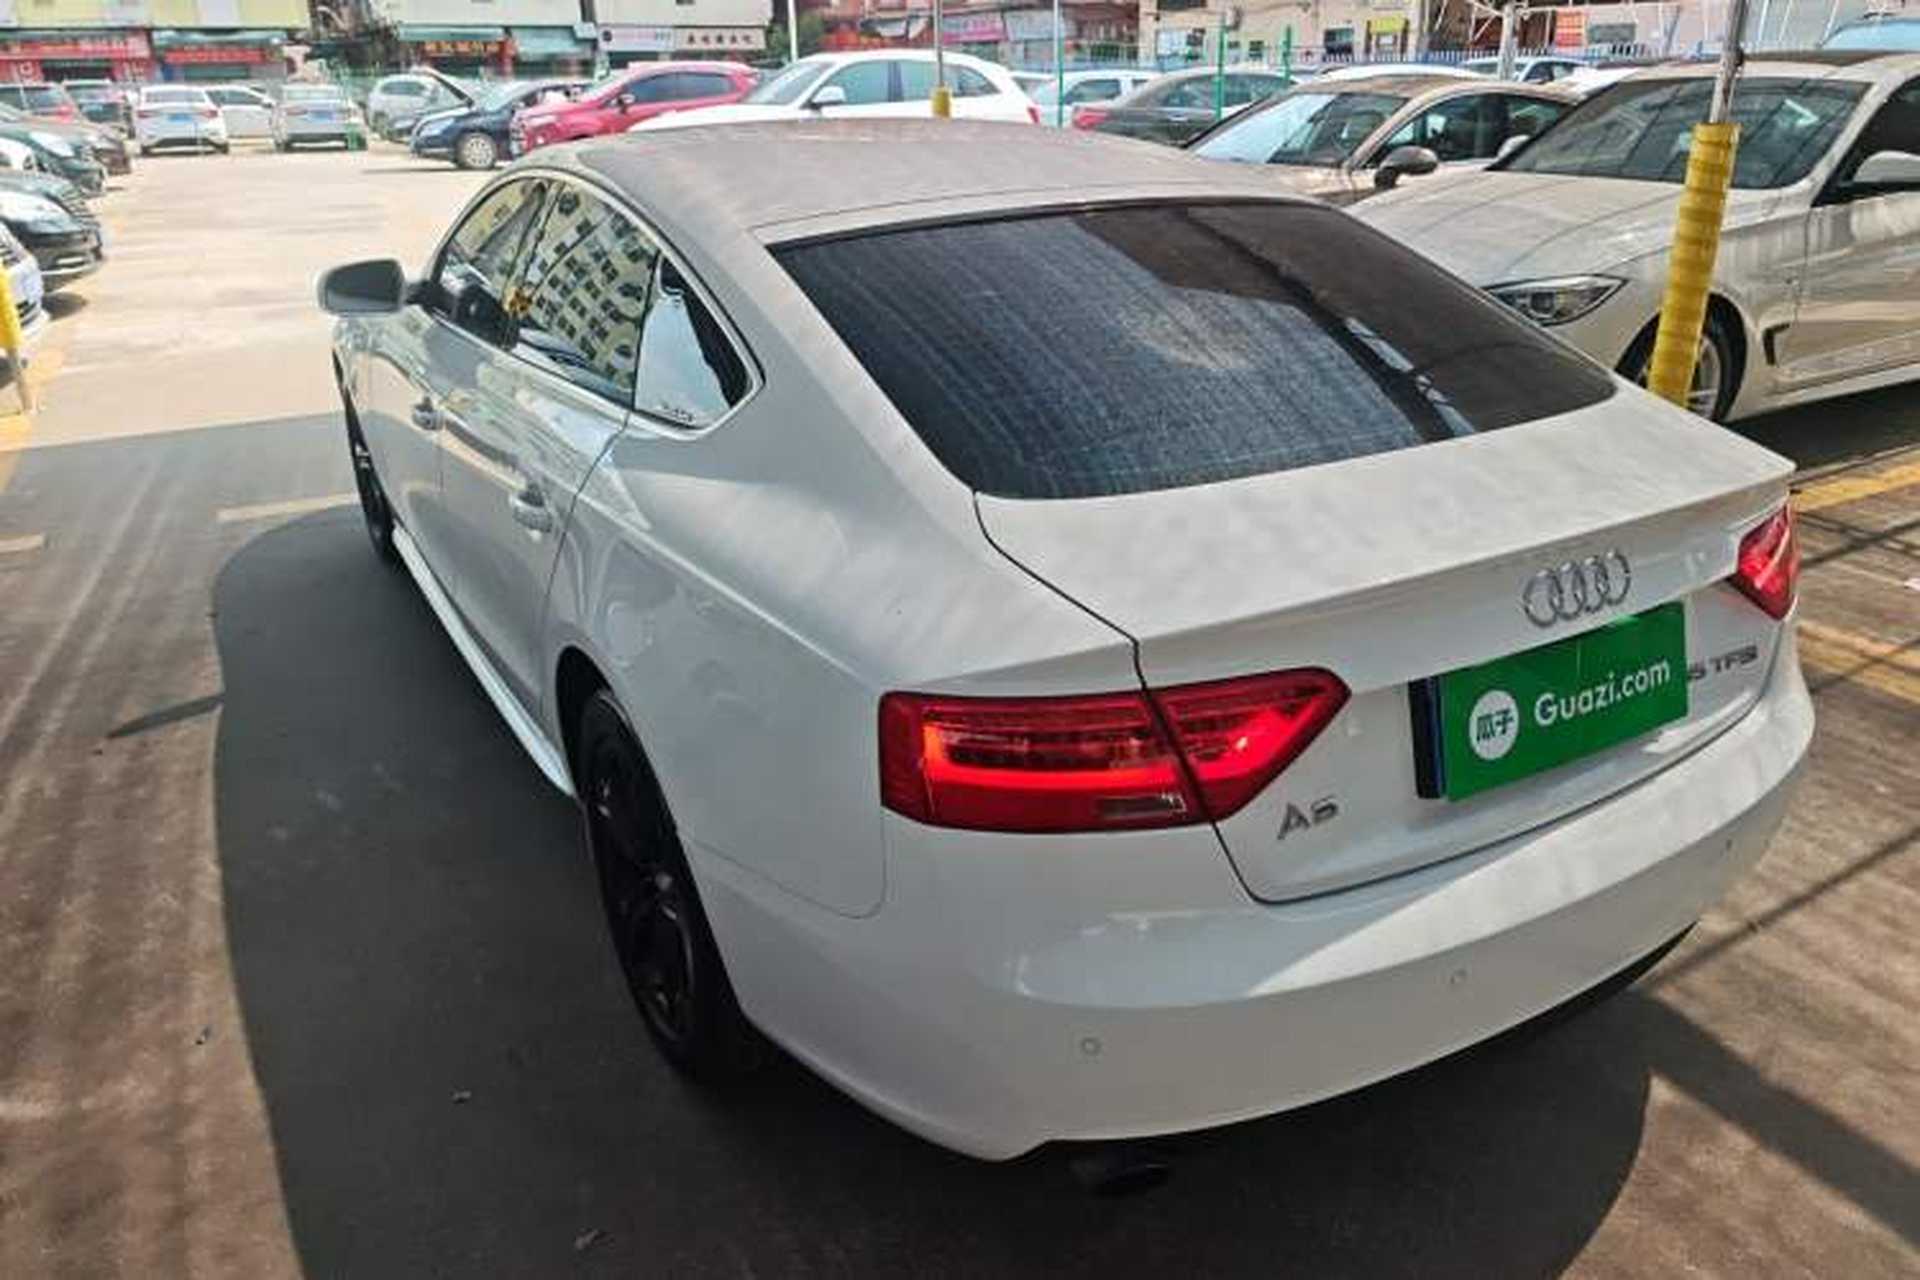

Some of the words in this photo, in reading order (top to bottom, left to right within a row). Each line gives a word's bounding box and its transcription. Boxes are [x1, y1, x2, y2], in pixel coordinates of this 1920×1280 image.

[1476, 708, 1515, 742] 瓜子
[1534, 658, 1671, 726] Guazi.com
[1277, 793, 1339, 841] A5
